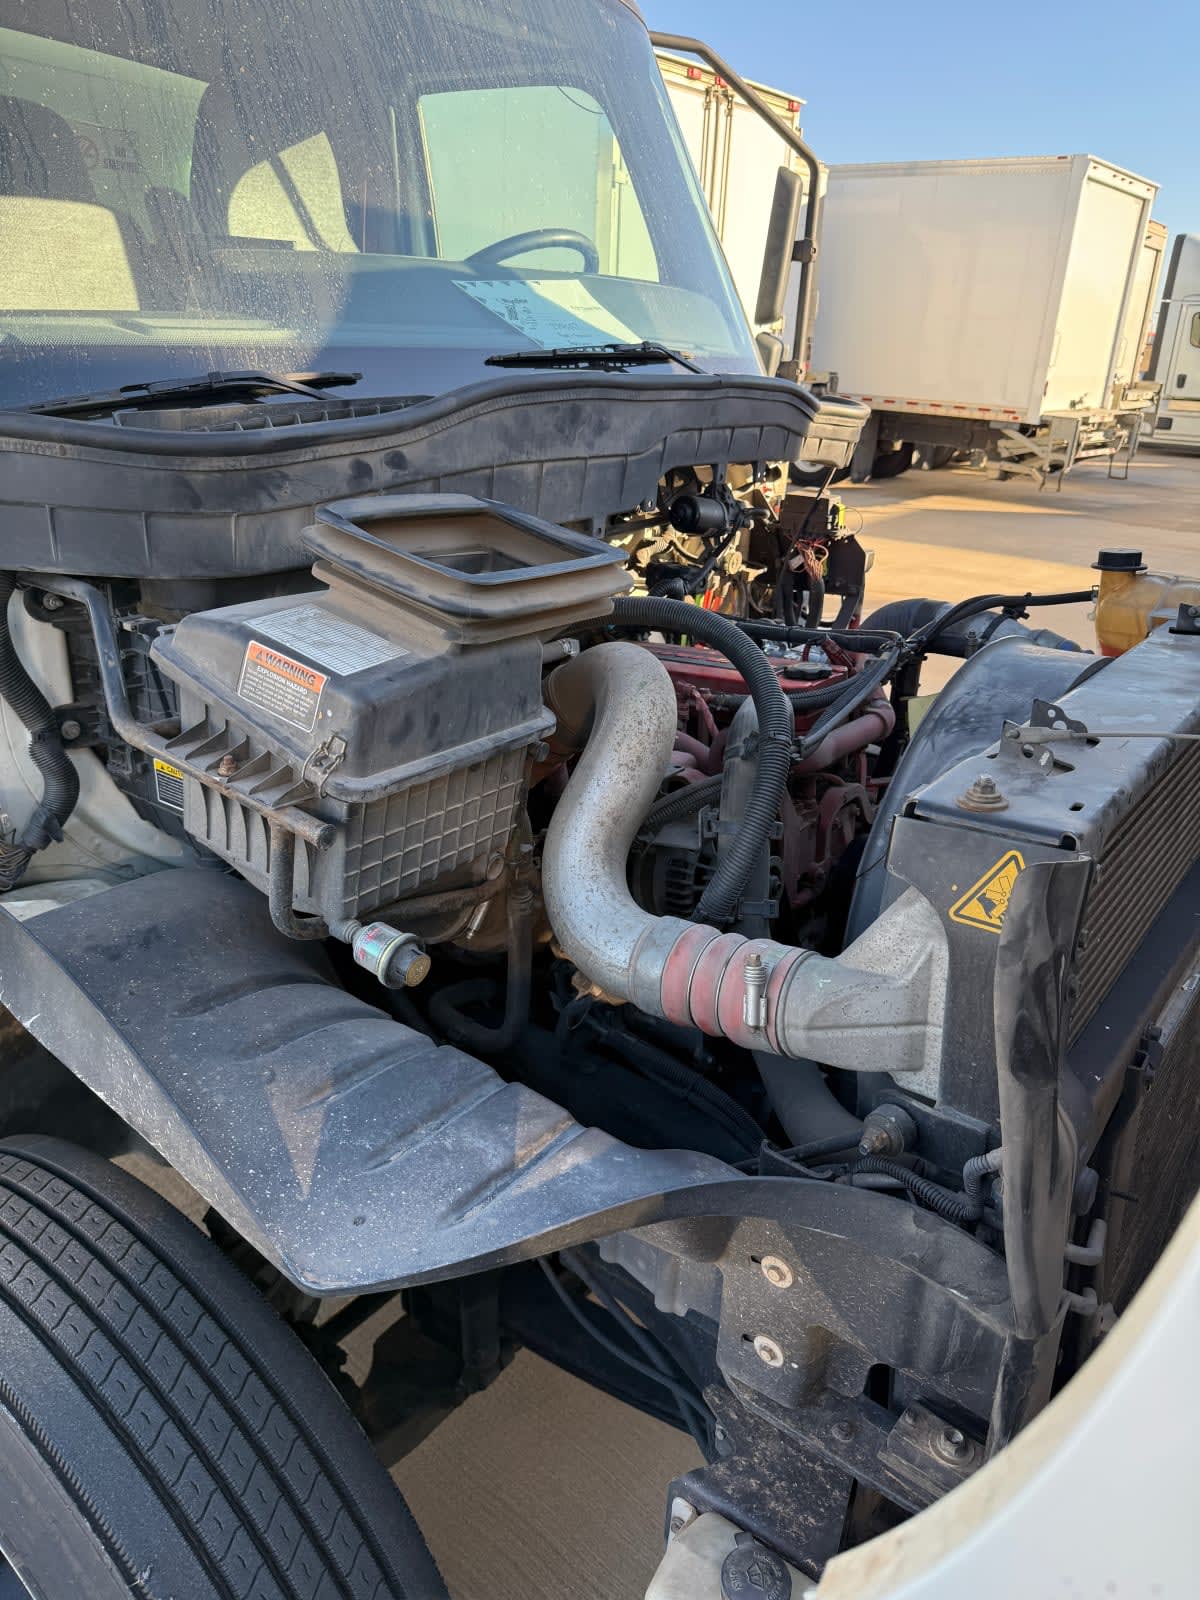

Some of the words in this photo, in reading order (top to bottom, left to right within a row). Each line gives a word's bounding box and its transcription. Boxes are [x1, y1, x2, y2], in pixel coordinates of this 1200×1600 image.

[256, 665, 287, 685] EXPLOSION
[286, 679, 308, 695] HAZARD
[265, 652, 317, 686] WARNING
